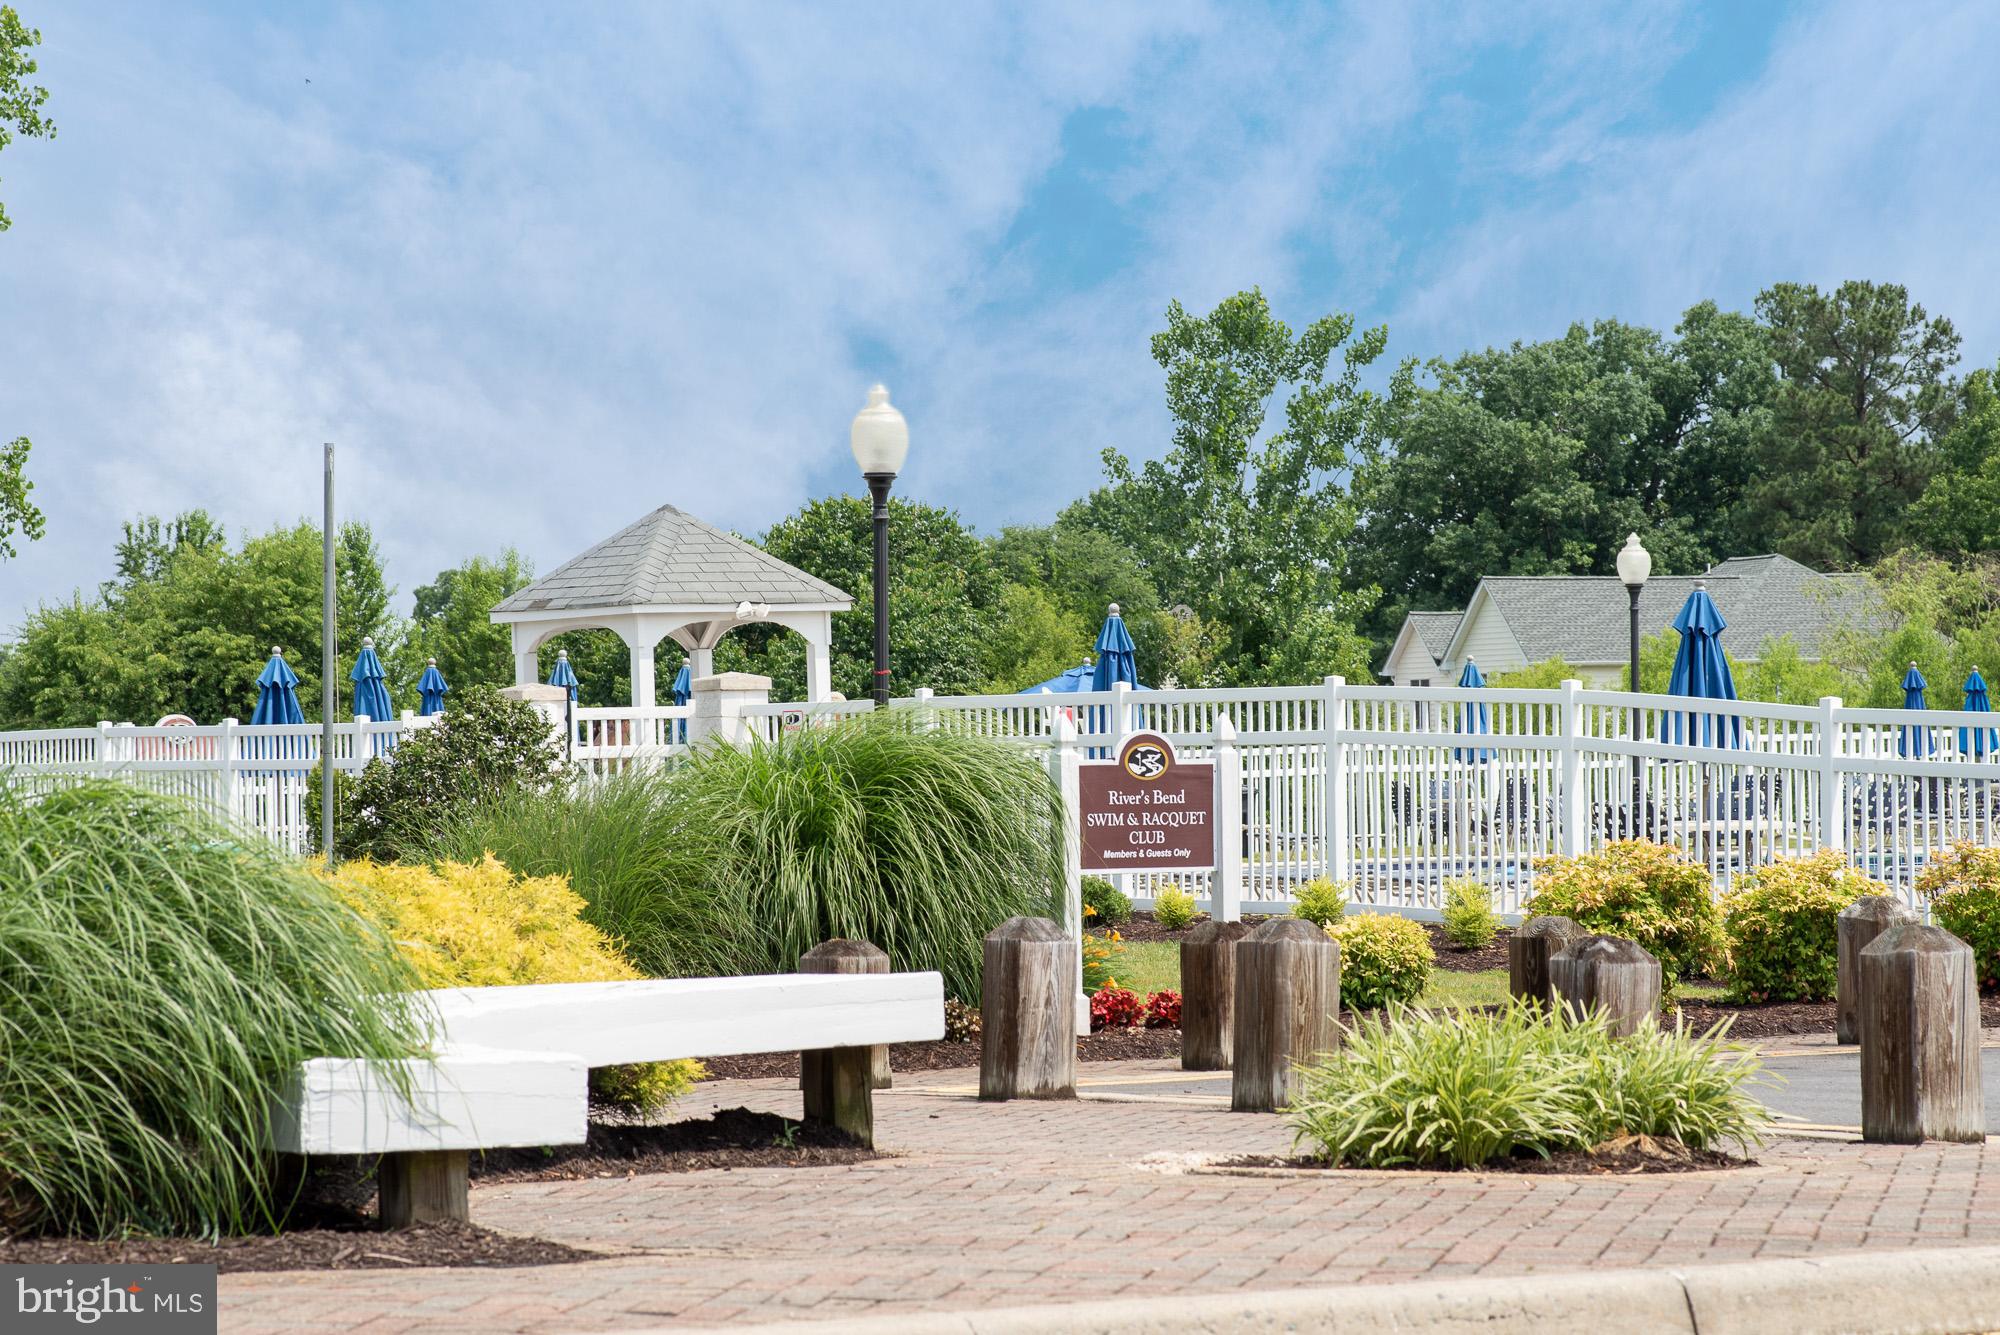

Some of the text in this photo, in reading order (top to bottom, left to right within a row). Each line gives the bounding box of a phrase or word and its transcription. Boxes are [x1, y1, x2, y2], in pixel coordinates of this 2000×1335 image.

[1108, 789, 1185, 805] River's Bend
[1087, 811, 1206, 828] SWIM & RACQUET
[1129, 830, 1165, 845] CLUB
[1103, 848, 1191, 859] Members & Guests Only
